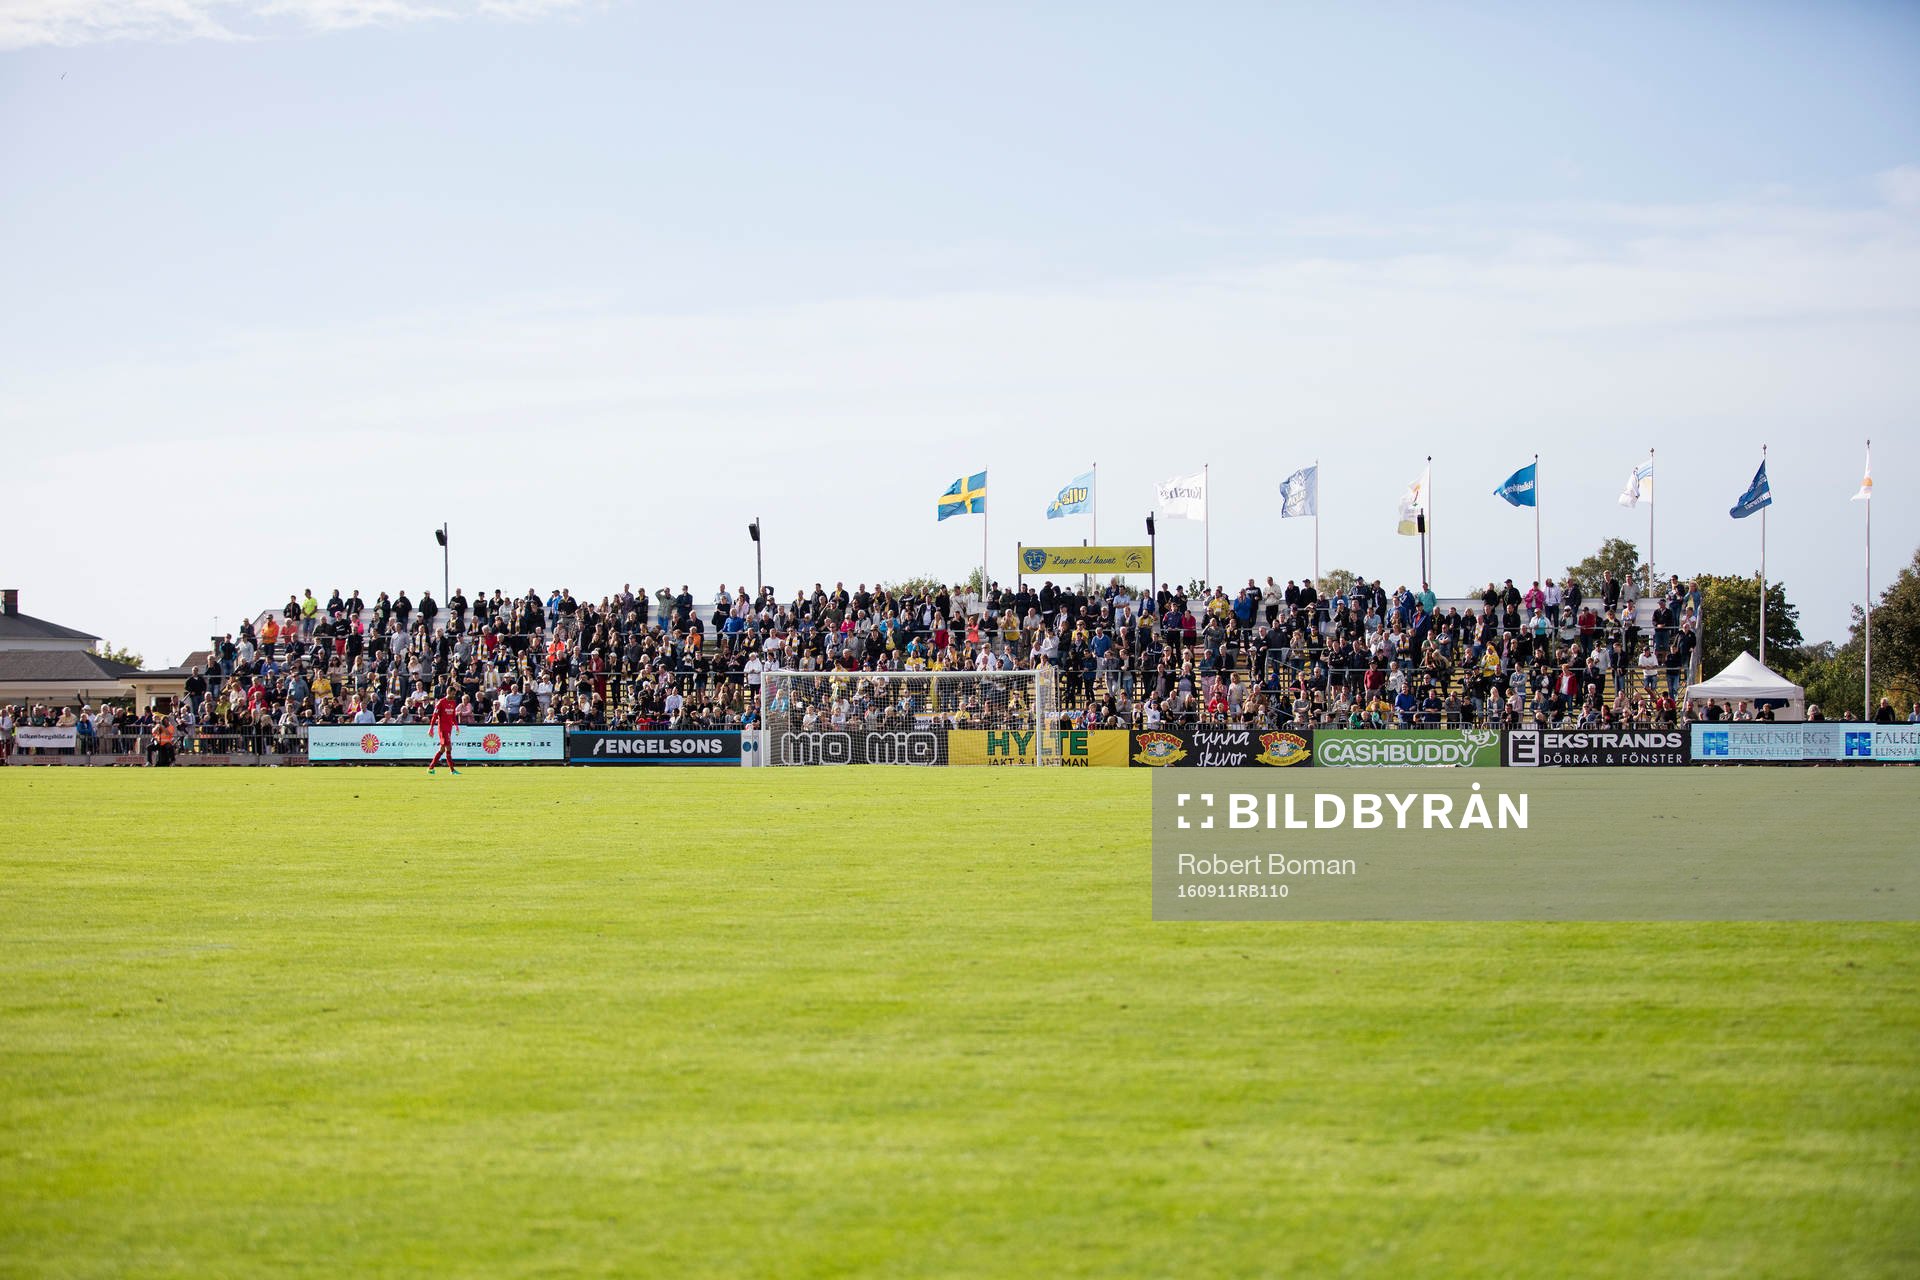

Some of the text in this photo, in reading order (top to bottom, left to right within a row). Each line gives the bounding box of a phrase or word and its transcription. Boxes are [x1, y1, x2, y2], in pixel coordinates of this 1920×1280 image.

[987, 731, 1089, 756] HYLTE
[1192, 731, 1250, 746] tunna
[1544, 733, 1682, 748] EKSTRANDS
[1733, 732, 1831, 744] FALKENBERGS
[1875, 732, 1920, 744] FALKE
[605, 739, 723, 754] ENGELSONS
[1324, 744, 1473, 762] CASHBUDDY
[1197, 742, 1247, 767] skivor
[1544, 753, 1682, 764] DÖRRAR & FÖNSTER
[988, 758, 1014, 767] JAKT
[1018, 758, 1026, 766] &
